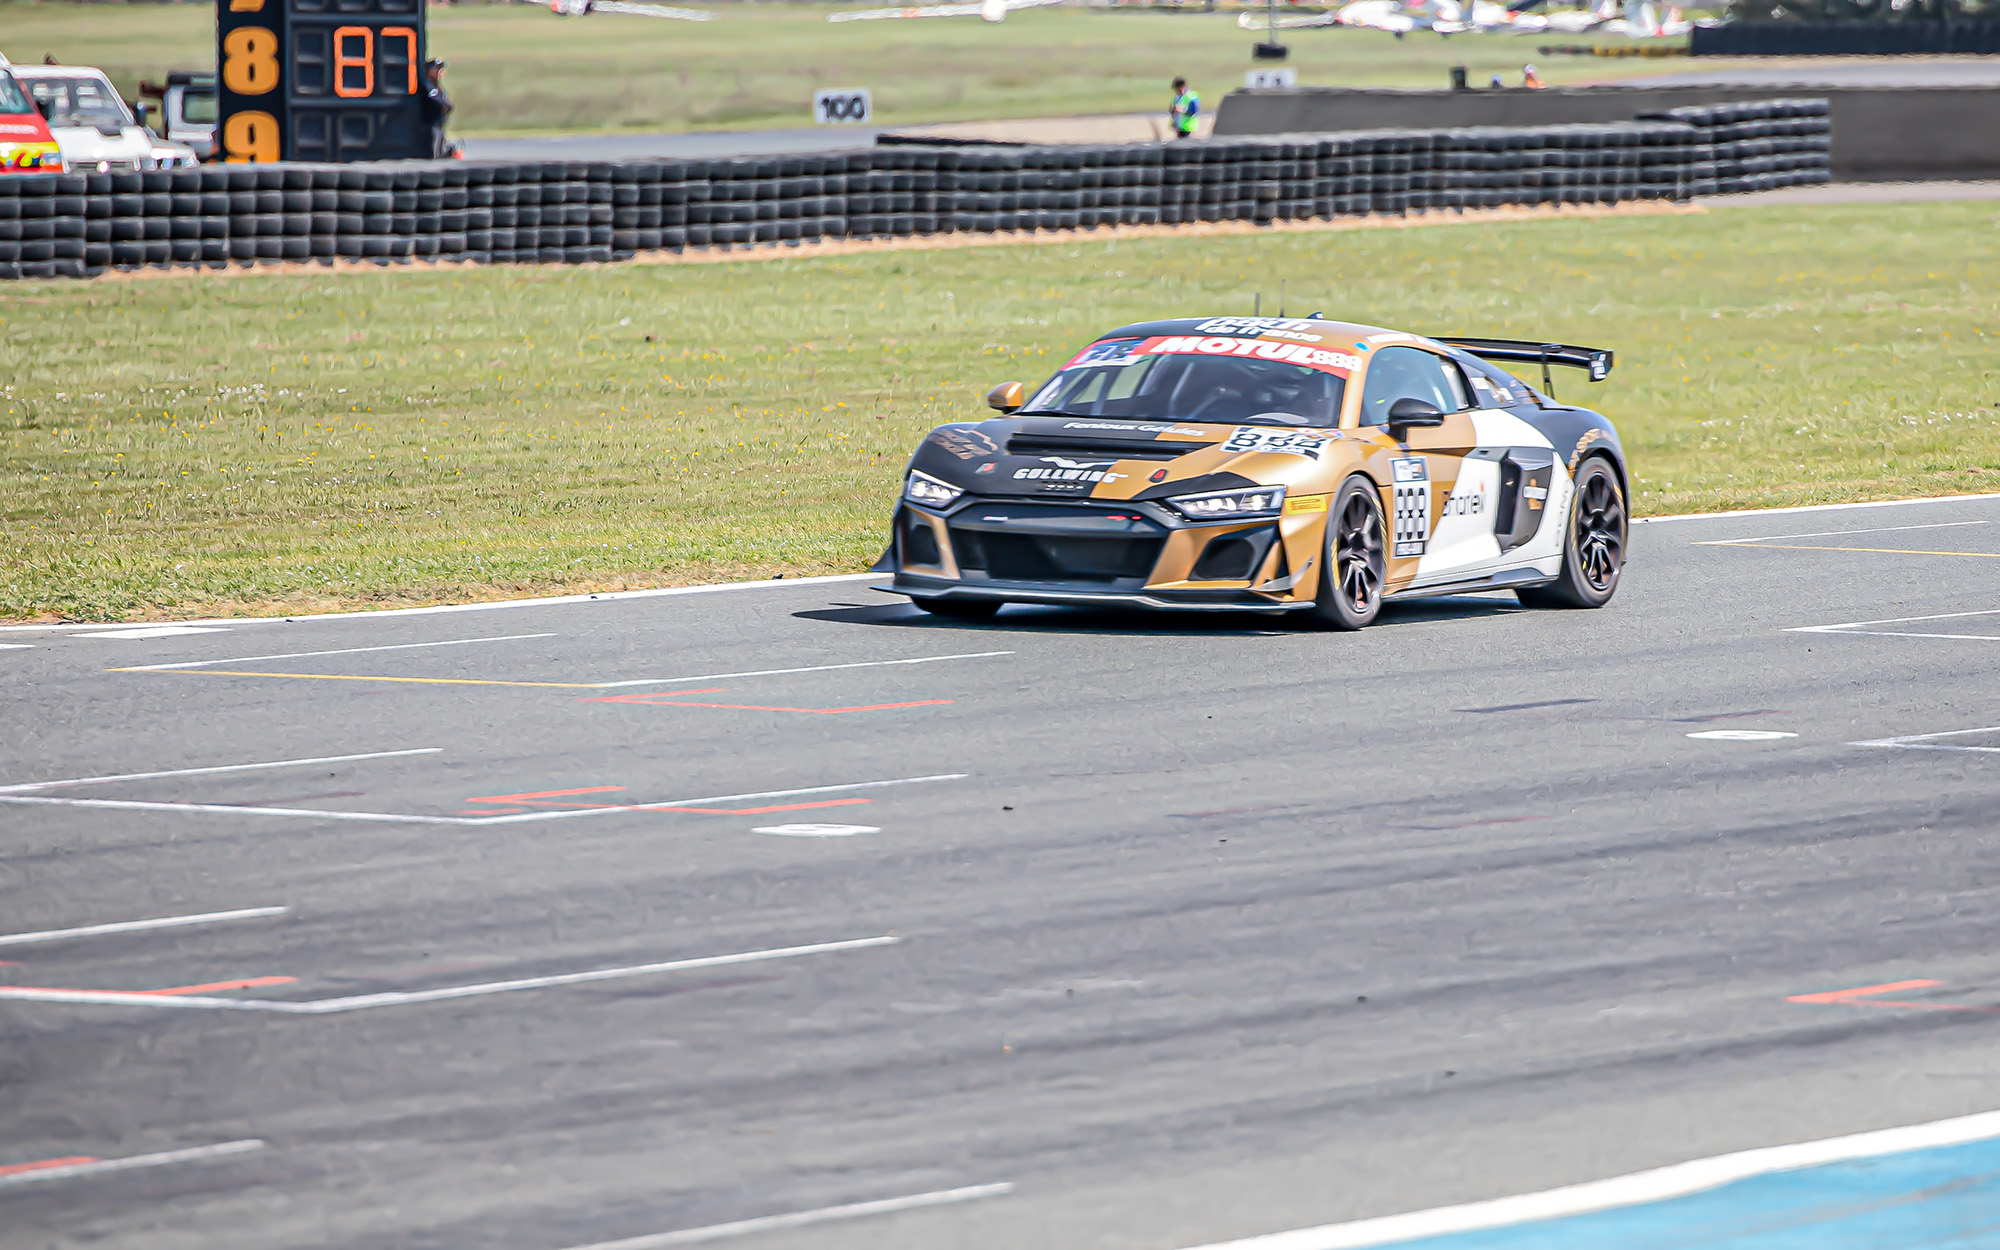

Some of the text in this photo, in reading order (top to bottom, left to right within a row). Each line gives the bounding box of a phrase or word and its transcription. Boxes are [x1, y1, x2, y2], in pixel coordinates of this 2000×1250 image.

[223, 26, 280, 95] 8
[334, 26, 418, 98] 87
[821, 96, 866, 120] 100
[223, 110, 281, 163] 9
[1150, 337, 1317, 366] MOTUL
